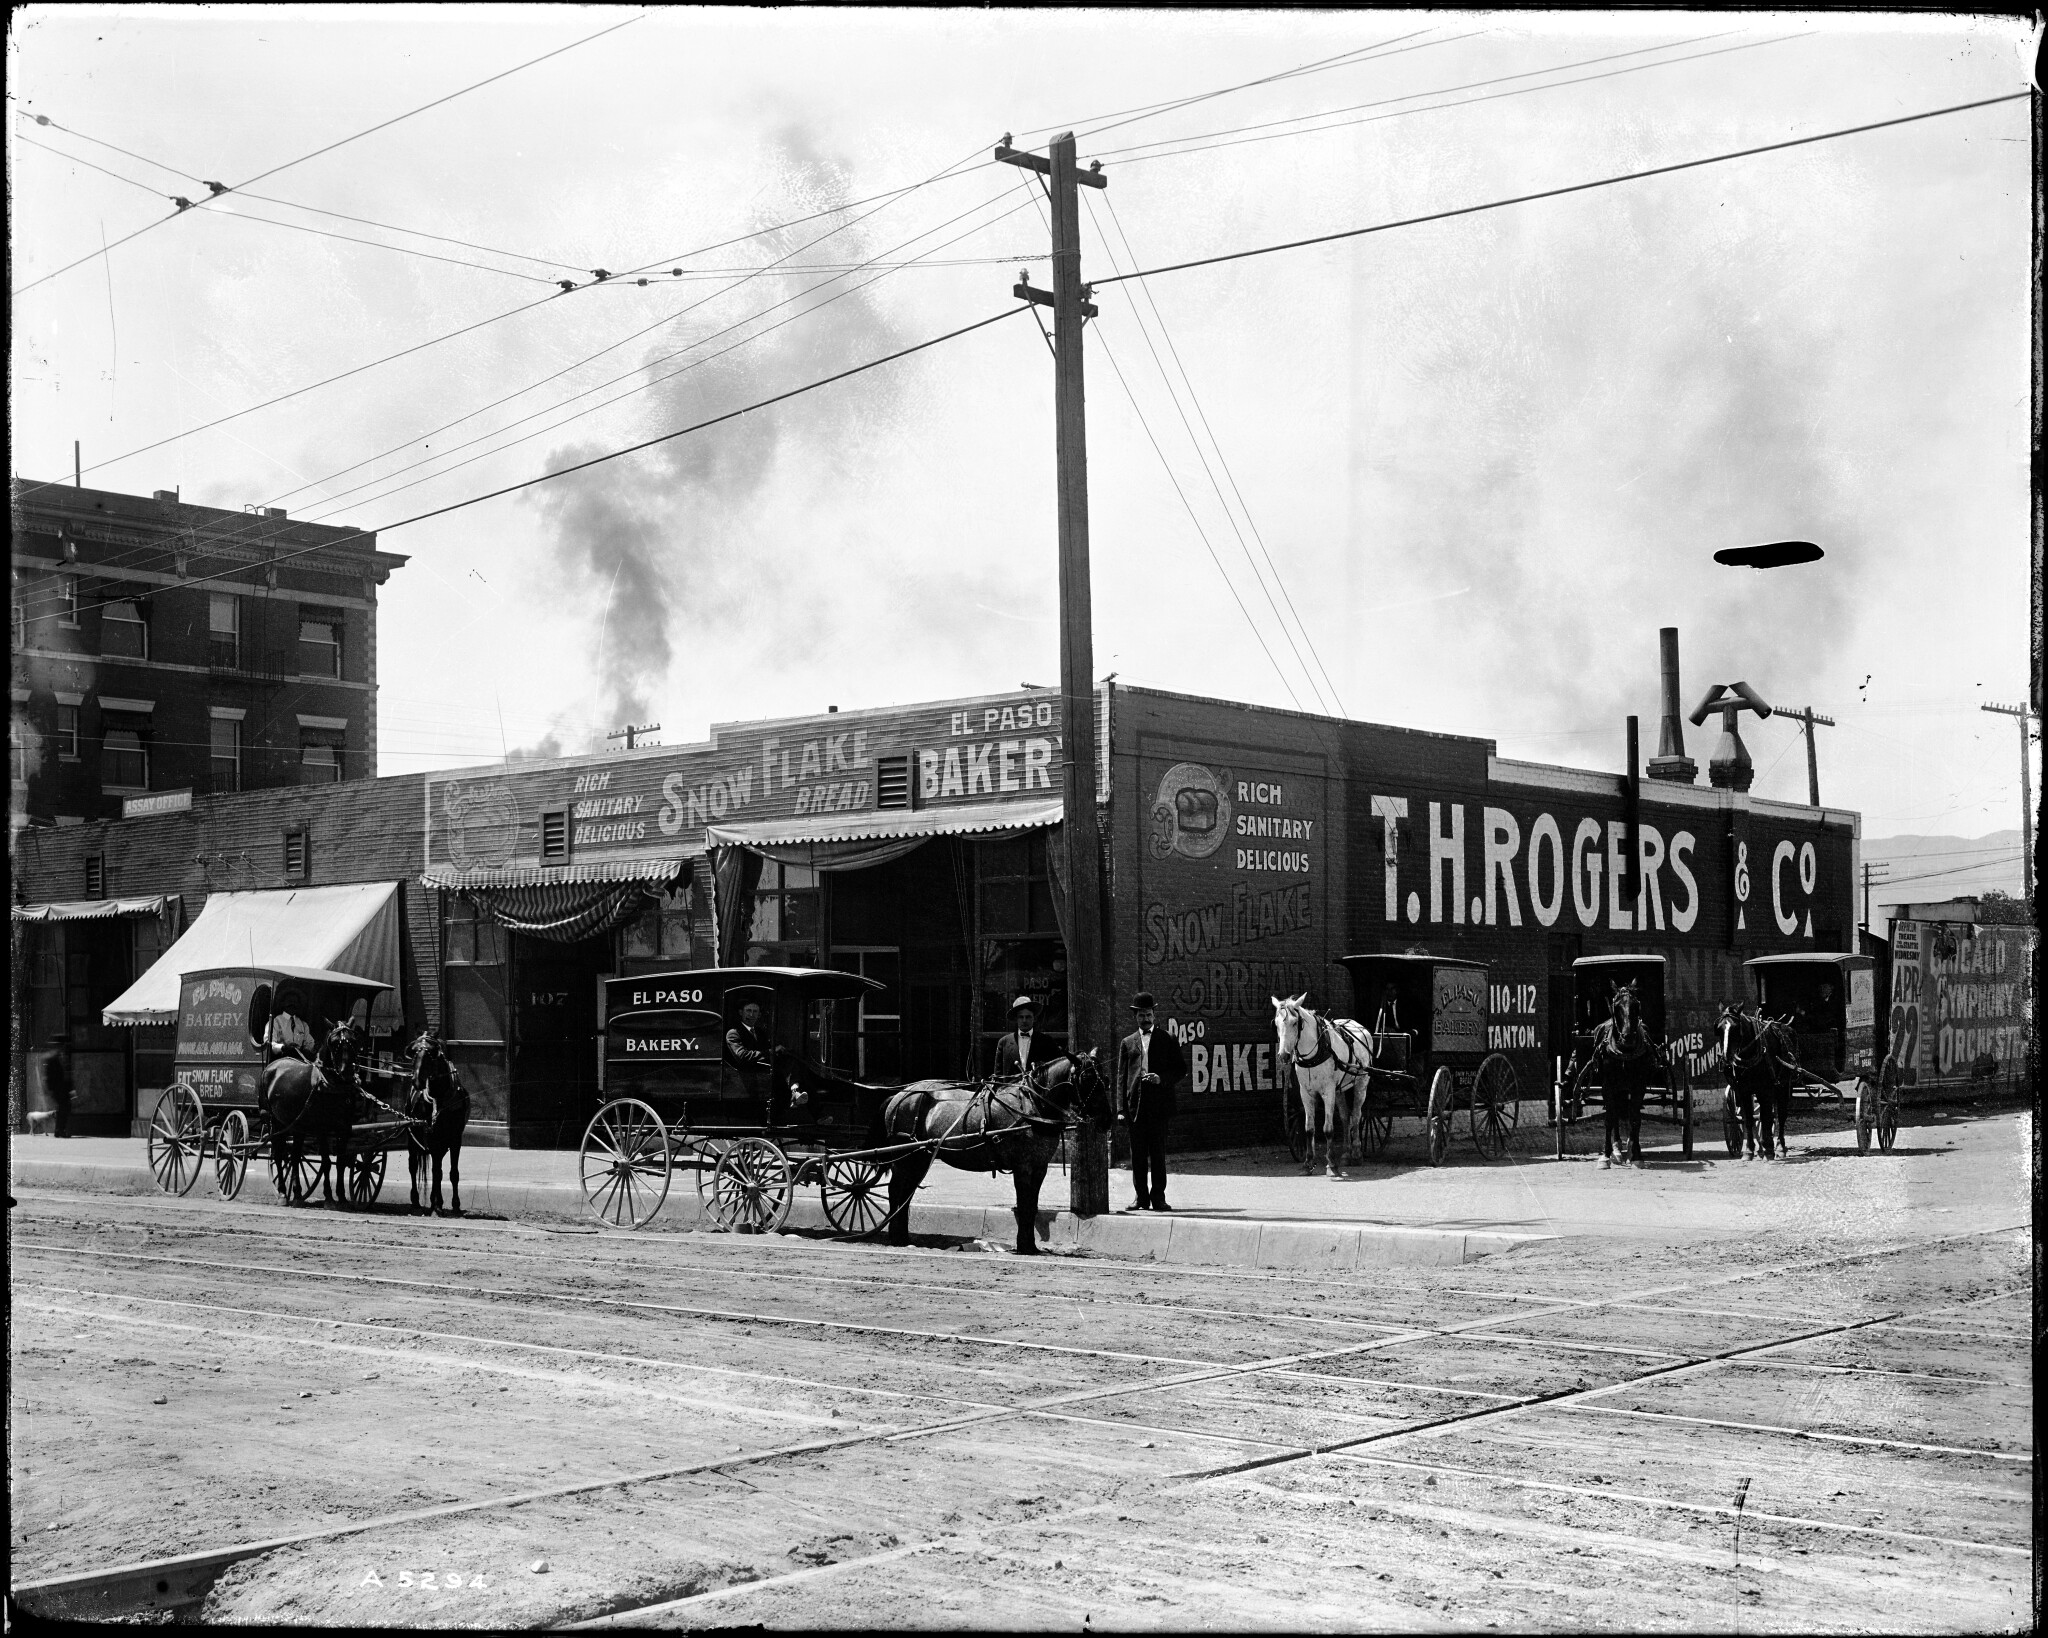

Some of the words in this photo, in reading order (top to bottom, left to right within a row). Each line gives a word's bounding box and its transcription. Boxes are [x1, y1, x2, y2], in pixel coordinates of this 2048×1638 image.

[951, 711, 974, 736] EL
[984, 702, 1052, 732] PASO
[762, 729, 869, 798] FLAKE
[918, 735, 1062, 799] BAKER
[574, 771, 611, 793] RICH
[1237, 781, 1282, 805] RICH
[125, 797, 155, 814] ASSAY
[156, 792, 190, 810] OFFICE
[574, 795, 644, 819] SANITARY
[794, 780, 870, 815] BREAD
[574, 821, 645, 845] DELICIOUS
[1236, 814, 1314, 841] SANITARY
[1236, 848, 1310, 873] DELICIOUS
[1484, 806, 1699, 933] ROGERS
[209, 979, 242, 1005] PASO
[1023, 976, 1049, 990] PASO
[1892, 965, 1919, 1003] APR
[530, 992, 568, 1006] 107
[633, 991, 651, 1005] EL
[655, 989, 703, 1004] PASO
[1490, 984, 1537, 1014] 110-112
[626, 1037, 699, 1052] BAKERY.
[1167, 1018, 1205, 1048] PASO
[1487, 1025, 1541, 1050] TANTON.
[1891, 1005, 1918, 1086] 22
[191, 1069, 211, 1083] SNOW
[211, 1069, 234, 1083] FLAKE
[200, 1085, 223, 1098] BREAD
